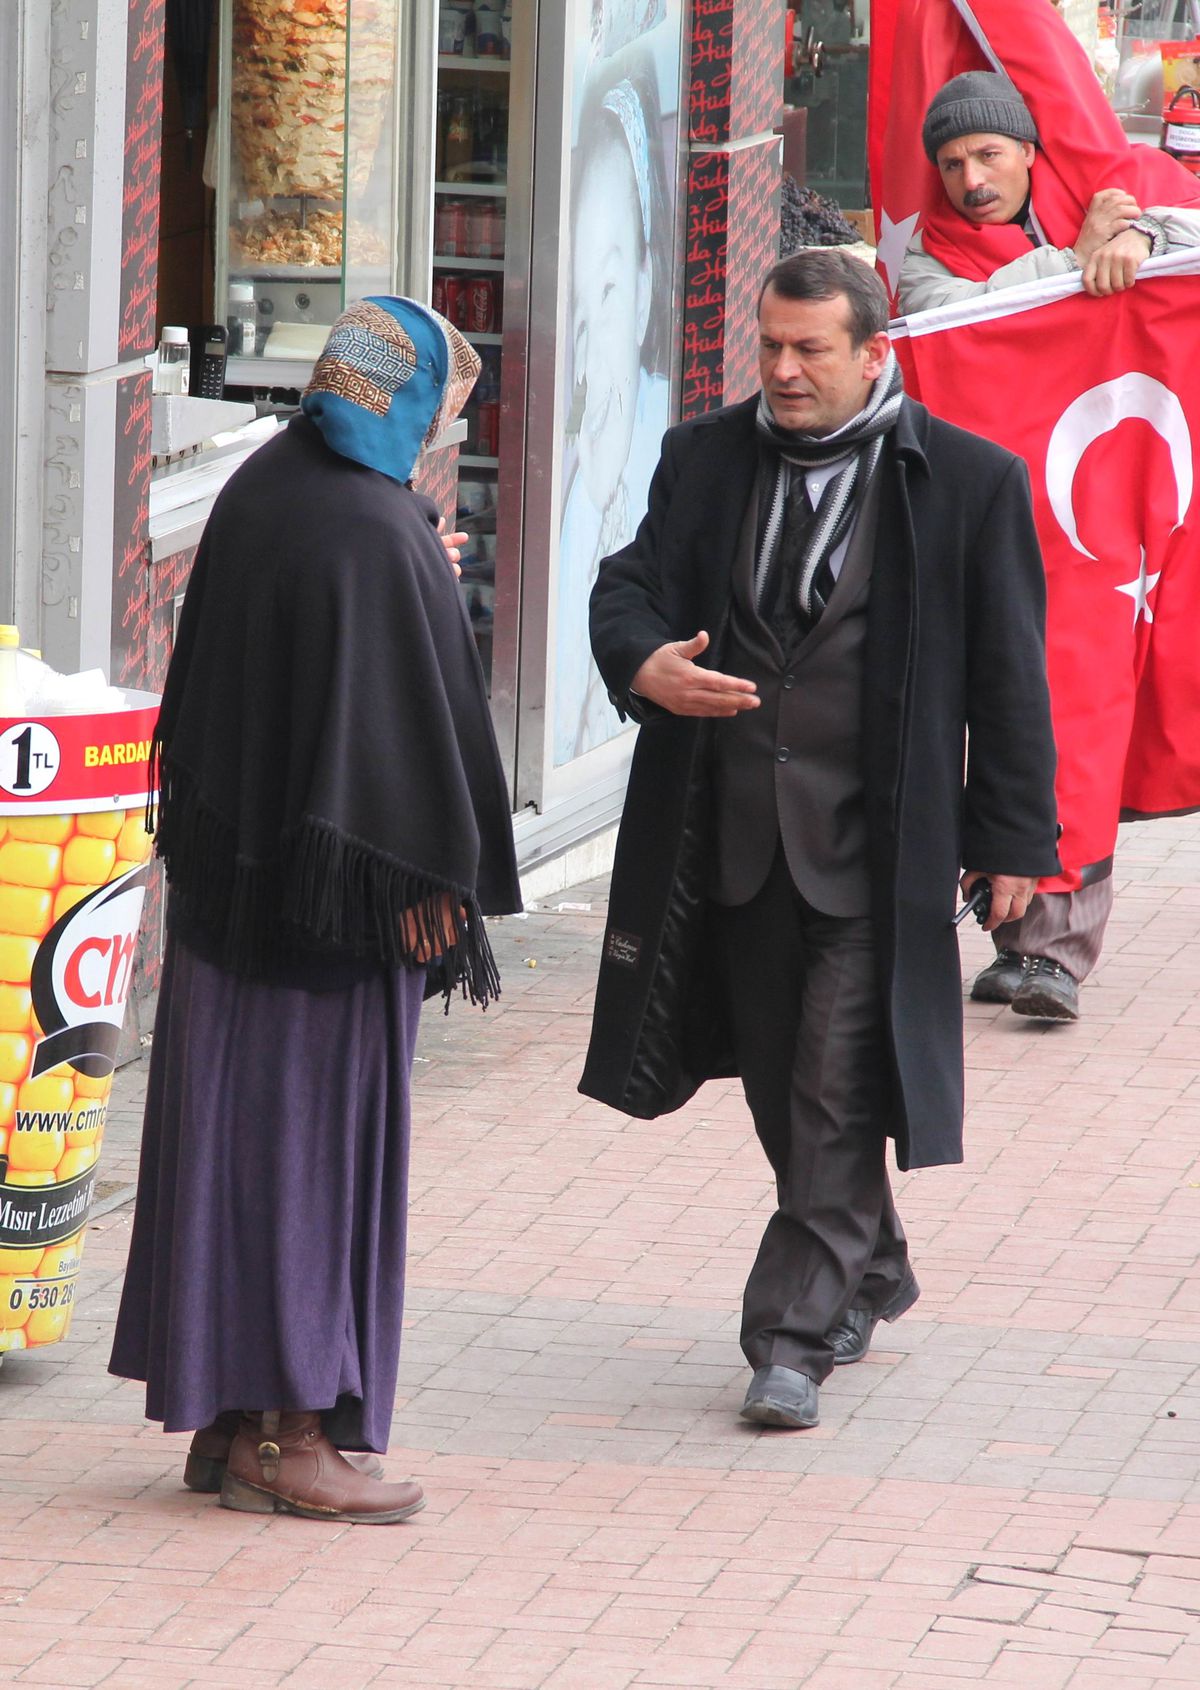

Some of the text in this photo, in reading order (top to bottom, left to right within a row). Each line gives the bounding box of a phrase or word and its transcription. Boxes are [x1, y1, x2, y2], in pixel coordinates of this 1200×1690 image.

[12, 727, 54, 790] 1 TL
[37, 1185, 88, 1230] Lezzetini
[10, 1289, 23, 1310] 0
[28, 1286, 58, 1309] 530
